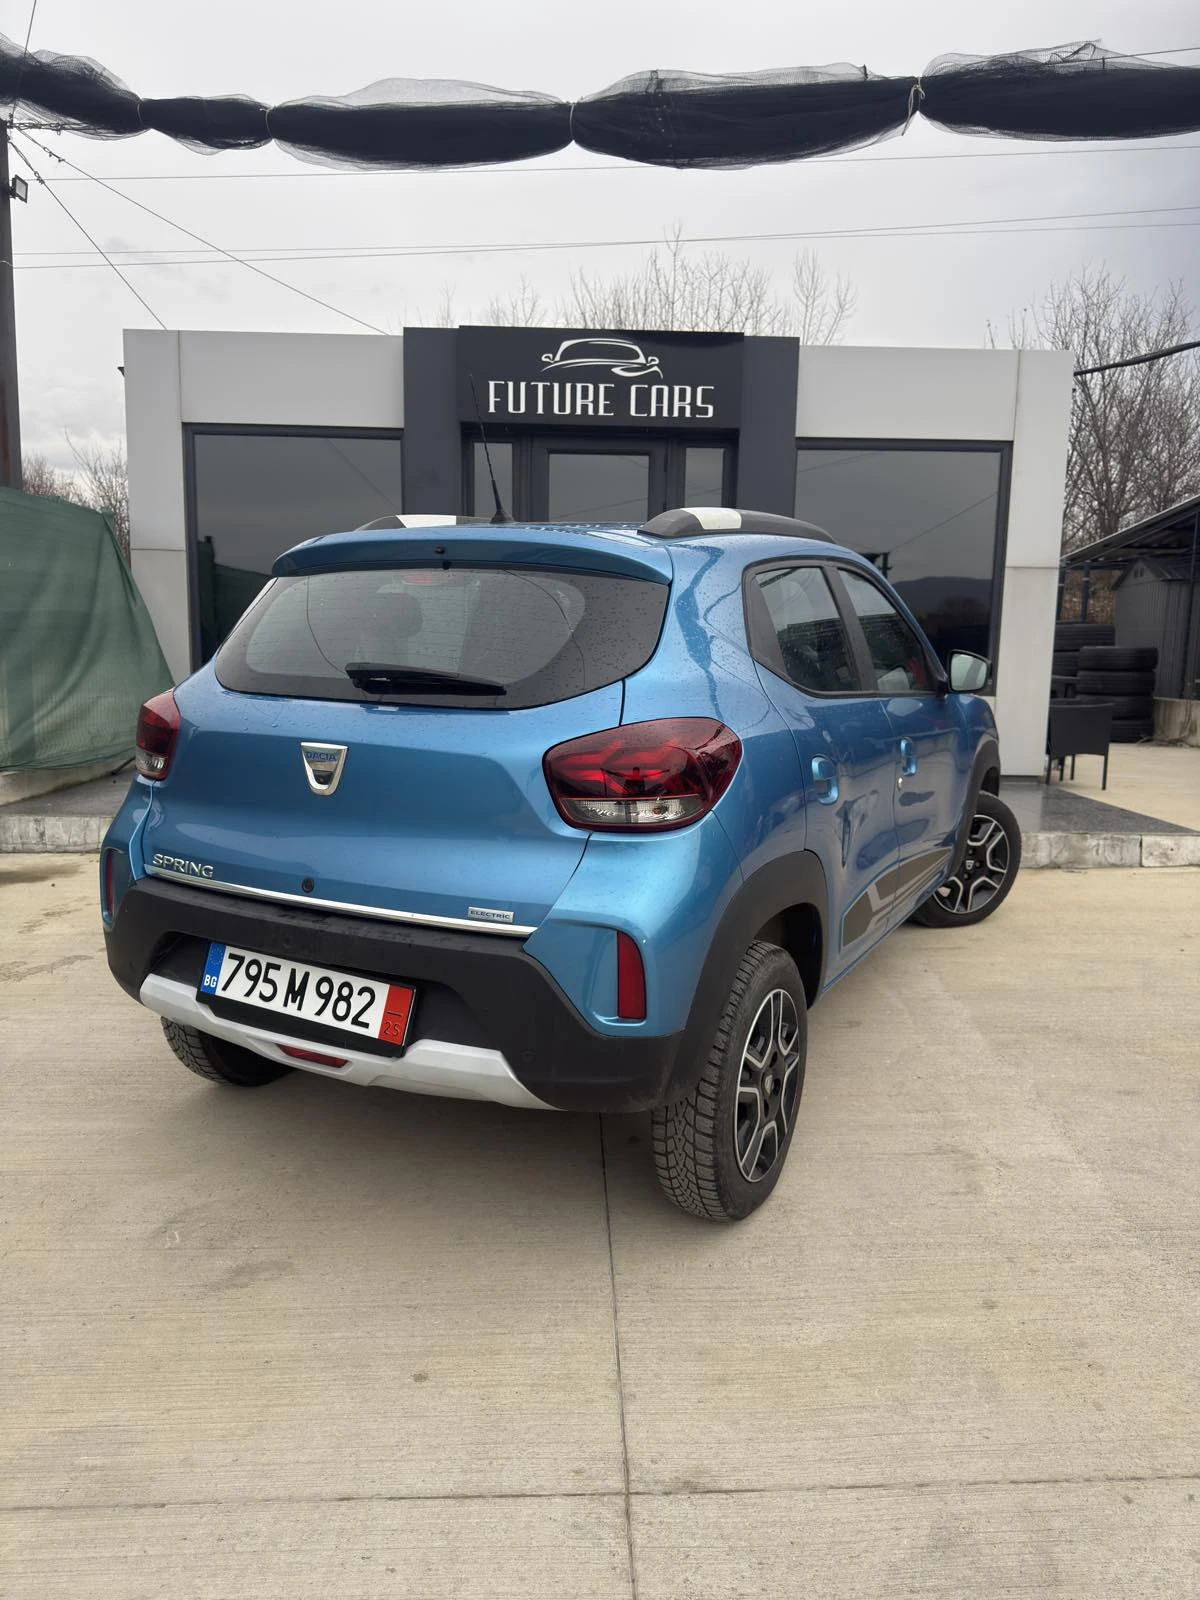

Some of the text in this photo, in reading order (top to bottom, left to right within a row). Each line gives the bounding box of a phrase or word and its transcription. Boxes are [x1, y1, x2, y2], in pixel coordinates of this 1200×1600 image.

[488, 380, 714, 418] FUTURE CARS
[152, 853, 214, 878] SPRING
[470, 910, 511, 920] ELECTRIC
[203, 974, 218, 988] BG
[222, 953, 376, 1029] 795 M 982
[383, 1021, 400, 1036] 25
